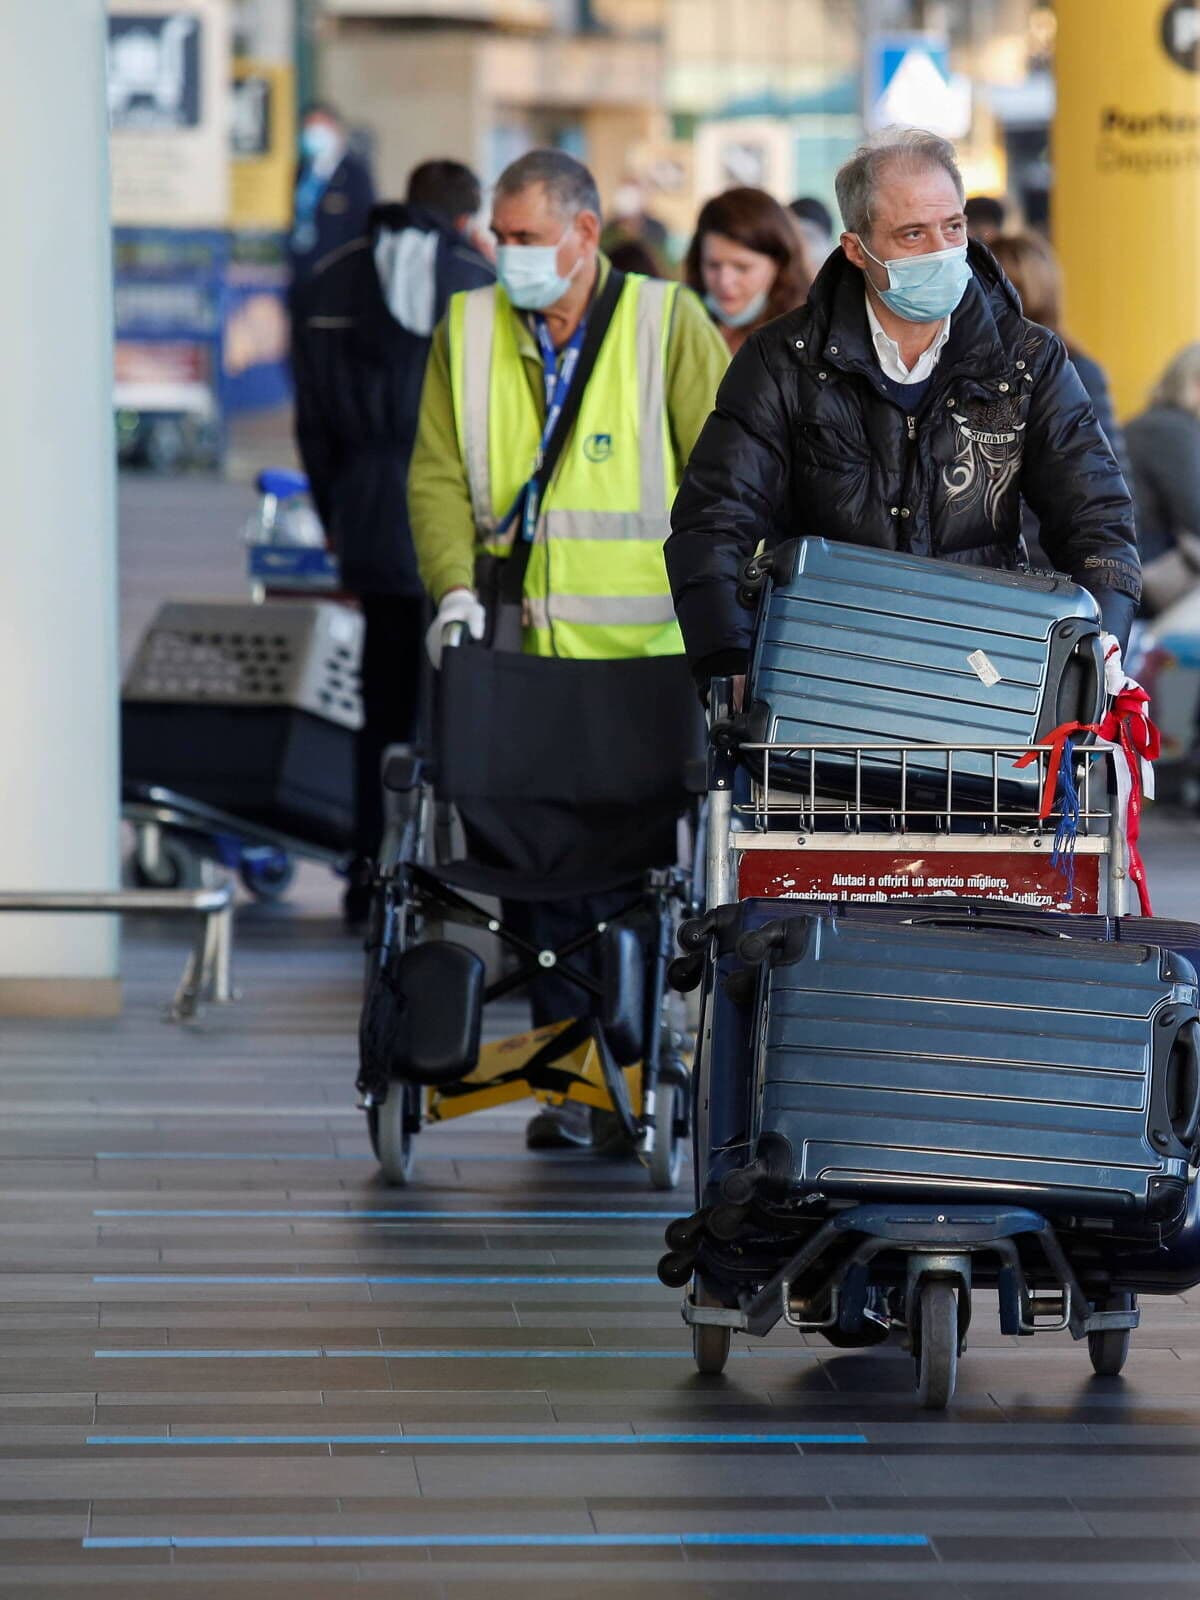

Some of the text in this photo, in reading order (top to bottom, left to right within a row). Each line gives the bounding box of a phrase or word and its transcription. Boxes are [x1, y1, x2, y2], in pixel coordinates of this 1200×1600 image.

[832, 873, 1010, 889] Aiutaci a offrirti un servizio migliore,
[841, 890, 848, 902] il
[850, 890, 888, 903] carrello
